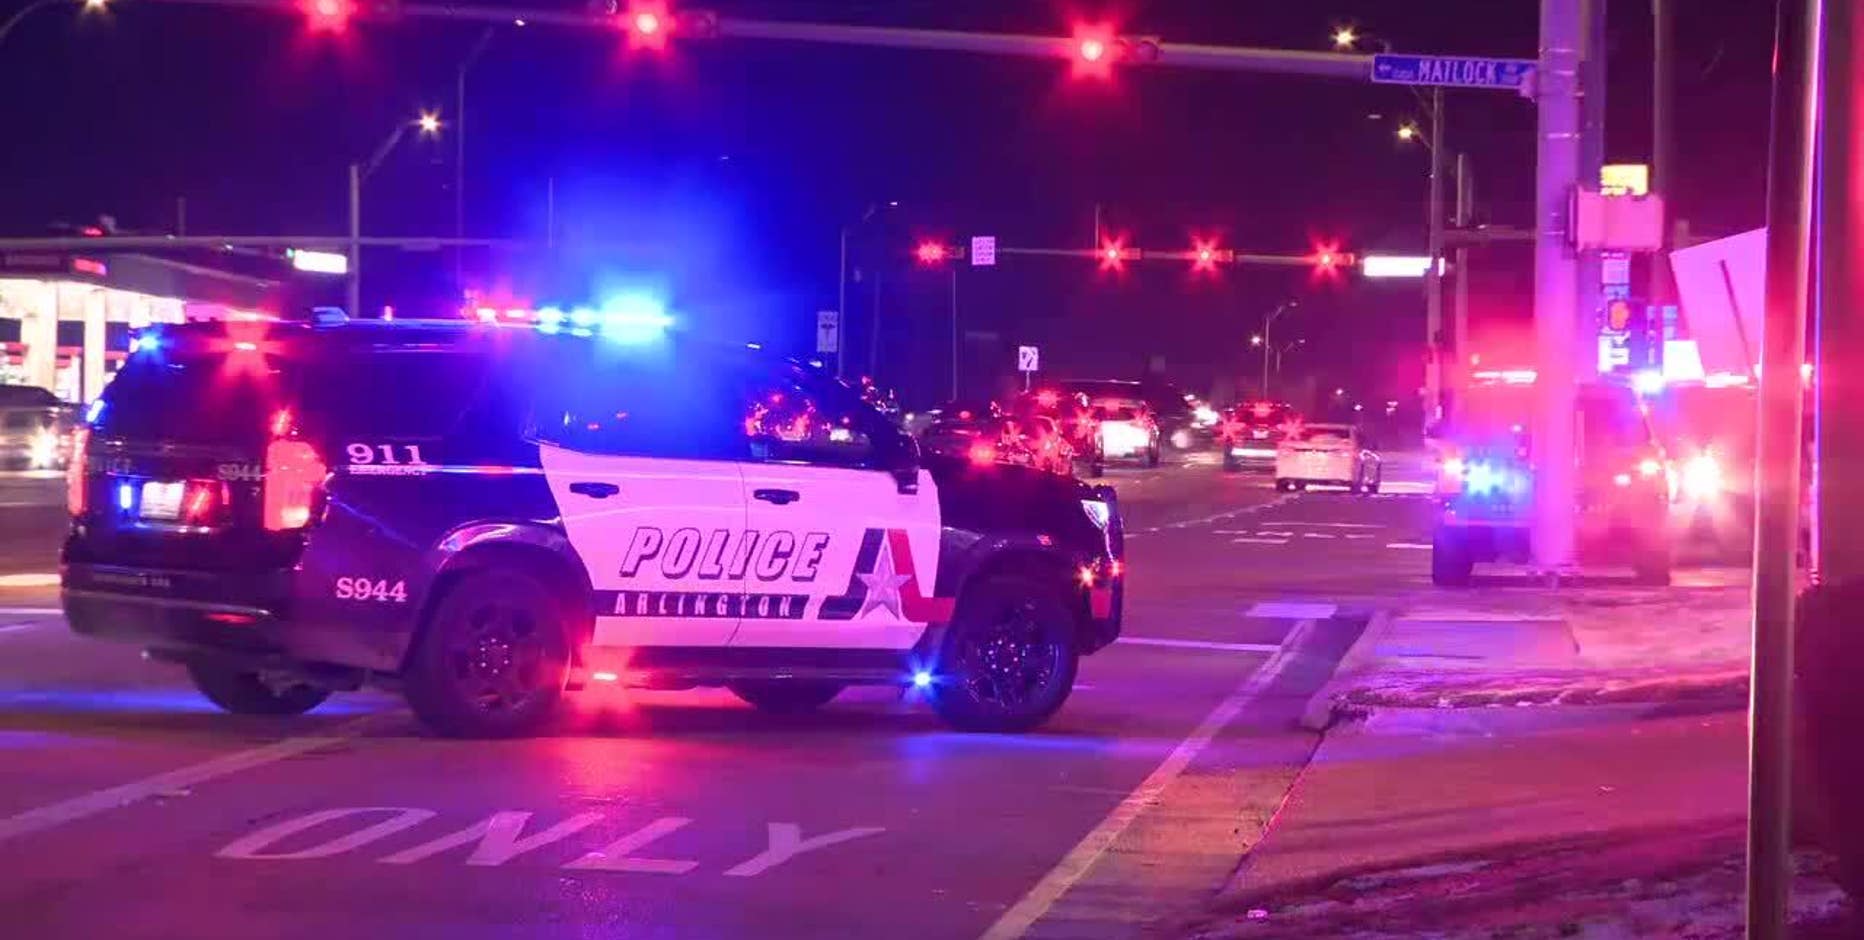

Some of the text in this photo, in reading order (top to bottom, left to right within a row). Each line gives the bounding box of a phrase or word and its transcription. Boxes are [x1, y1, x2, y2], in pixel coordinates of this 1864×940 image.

[1418, 60, 1497, 84] MATLOCK
[346, 443, 428, 465] 911
[619, 526, 830, 582] POLICE
[336, 577, 408, 602] S944
[613, 592, 793, 616] ARLINGTON
[212, 806, 886, 877] ONLY
